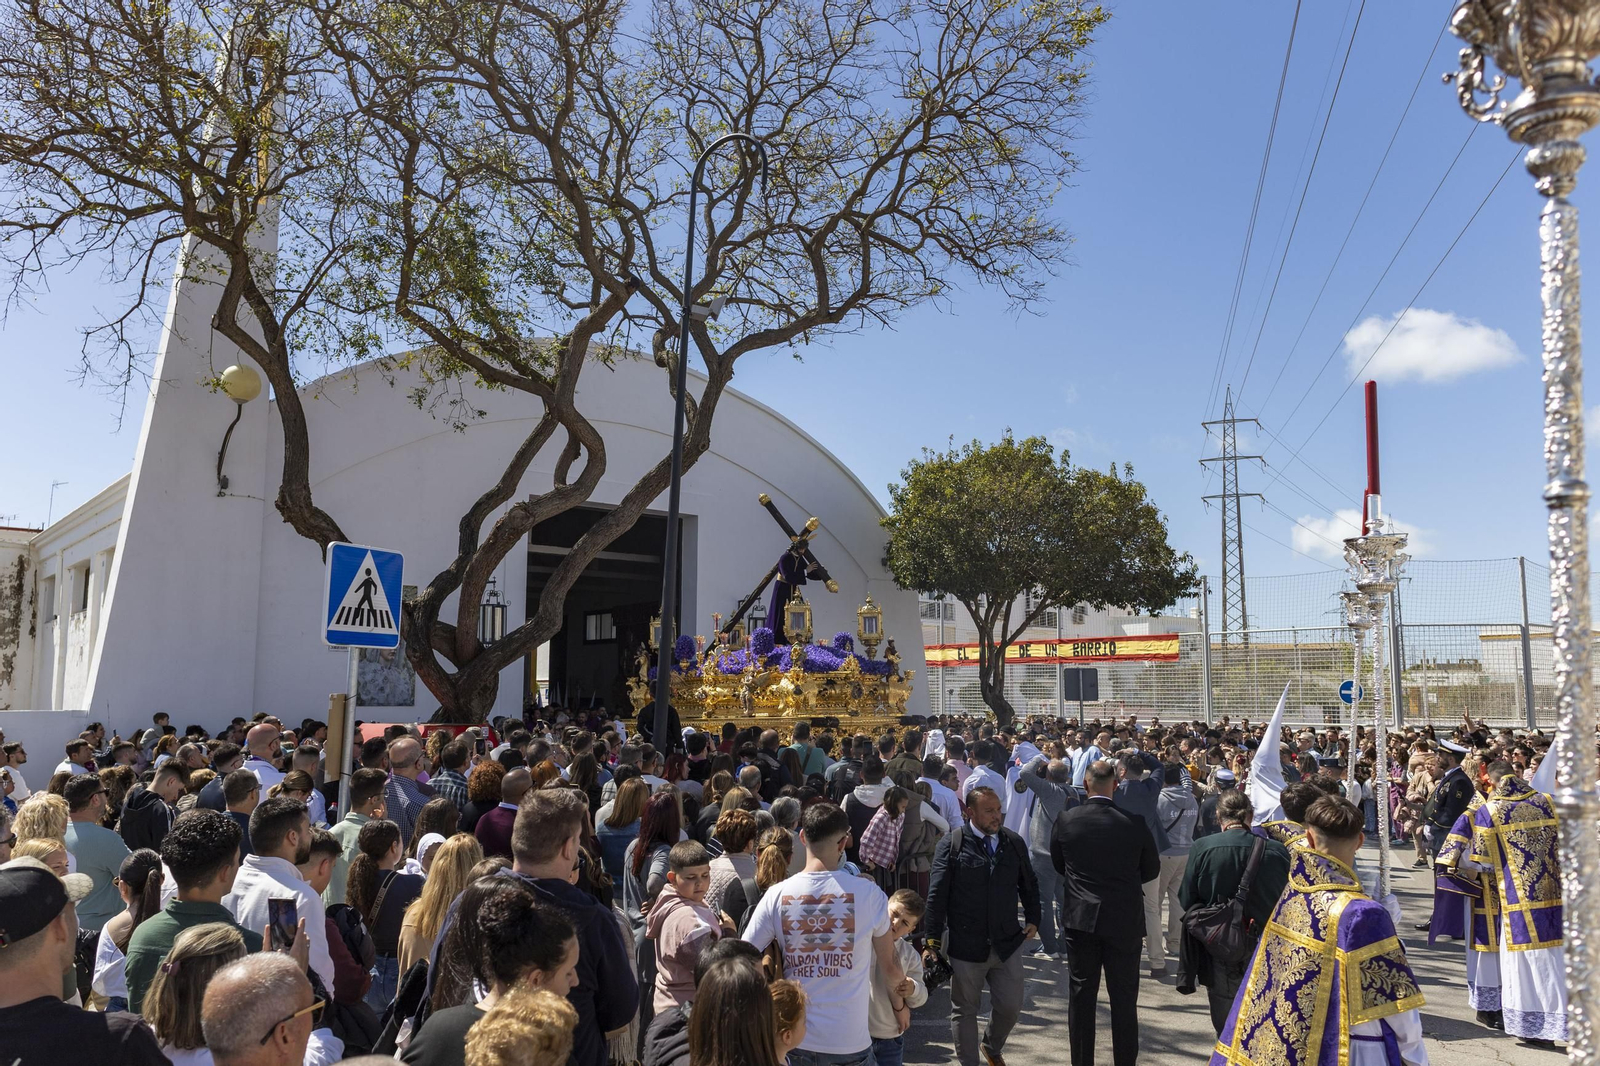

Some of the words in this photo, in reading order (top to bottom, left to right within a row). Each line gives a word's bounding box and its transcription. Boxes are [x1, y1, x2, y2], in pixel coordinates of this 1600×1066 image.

[957, 647, 969, 660] EL
[1018, 643, 1032, 658] DE
[1045, 643, 1058, 658] UN
[1072, 641, 1117, 657] BARRIO
[823, 953, 853, 969] VIBES
[793, 966, 815, 978] FREE
[817, 966, 841, 978] SOUL
